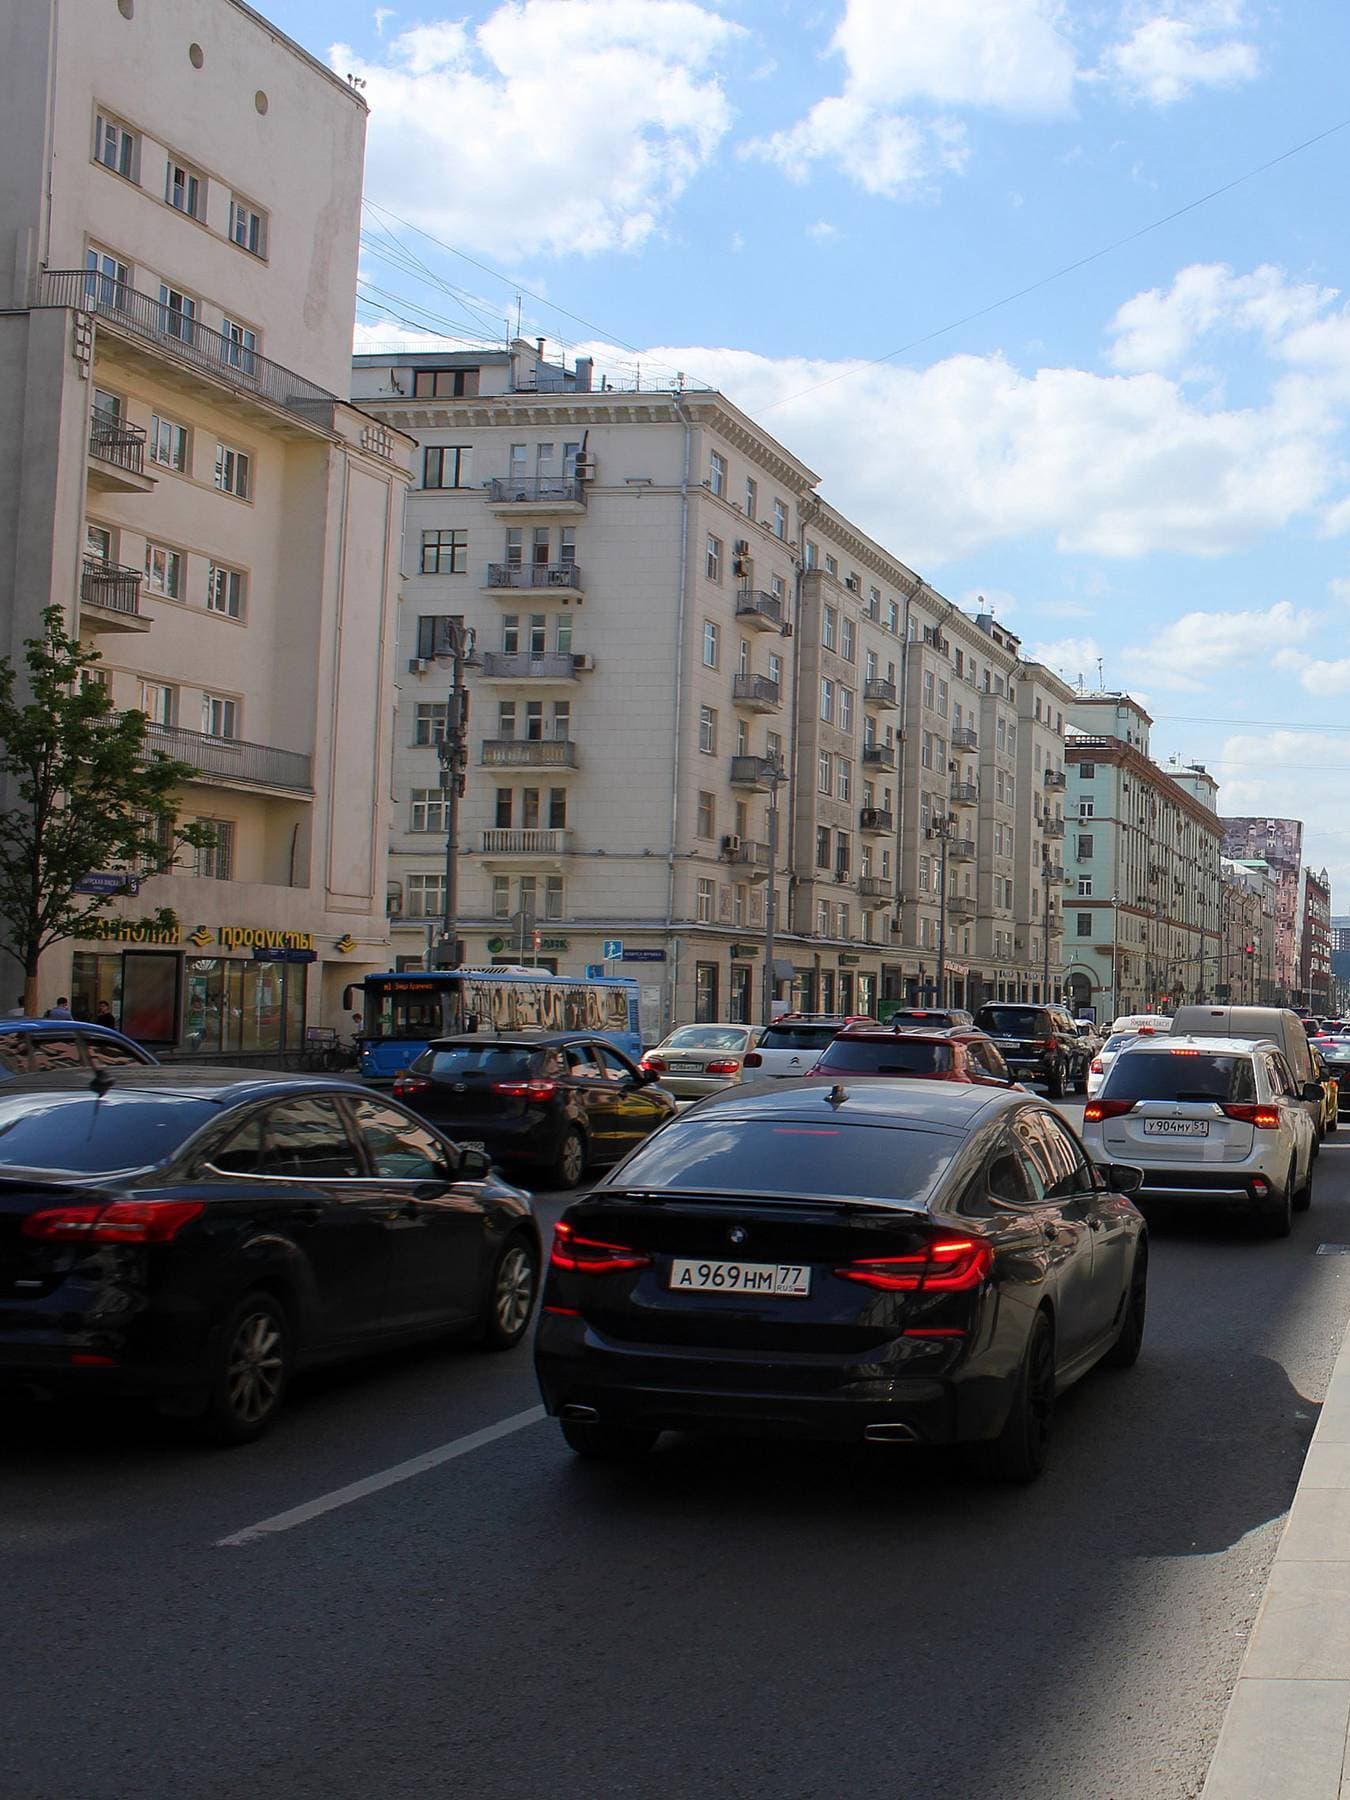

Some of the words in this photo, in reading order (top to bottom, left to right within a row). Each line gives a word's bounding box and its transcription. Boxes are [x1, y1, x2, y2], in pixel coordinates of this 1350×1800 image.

[1194, 1121, 1205, 1130] 51
[779, 1267, 803, 1285] 77
[776, 1284, 794, 1293] RUS
